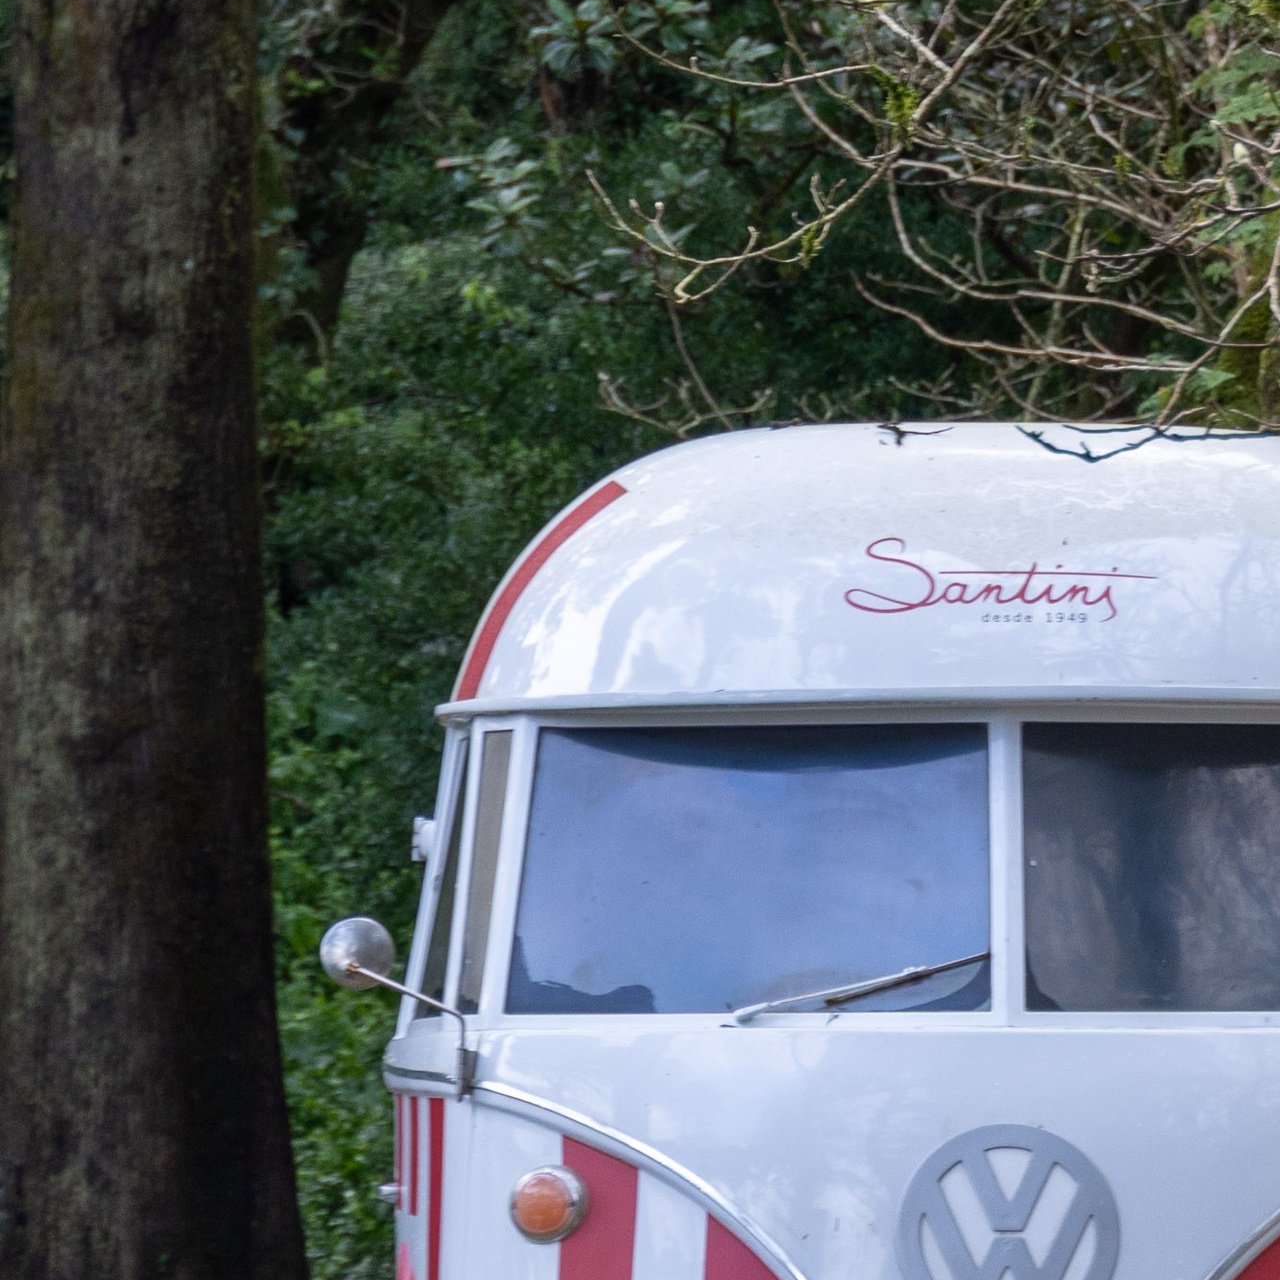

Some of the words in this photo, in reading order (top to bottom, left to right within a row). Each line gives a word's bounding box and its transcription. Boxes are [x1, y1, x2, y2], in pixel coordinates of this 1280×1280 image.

[844, 537, 1158, 622] Santini
[980, 612, 1034, 623] desde
[1044, 611, 1089, 623] 1949
